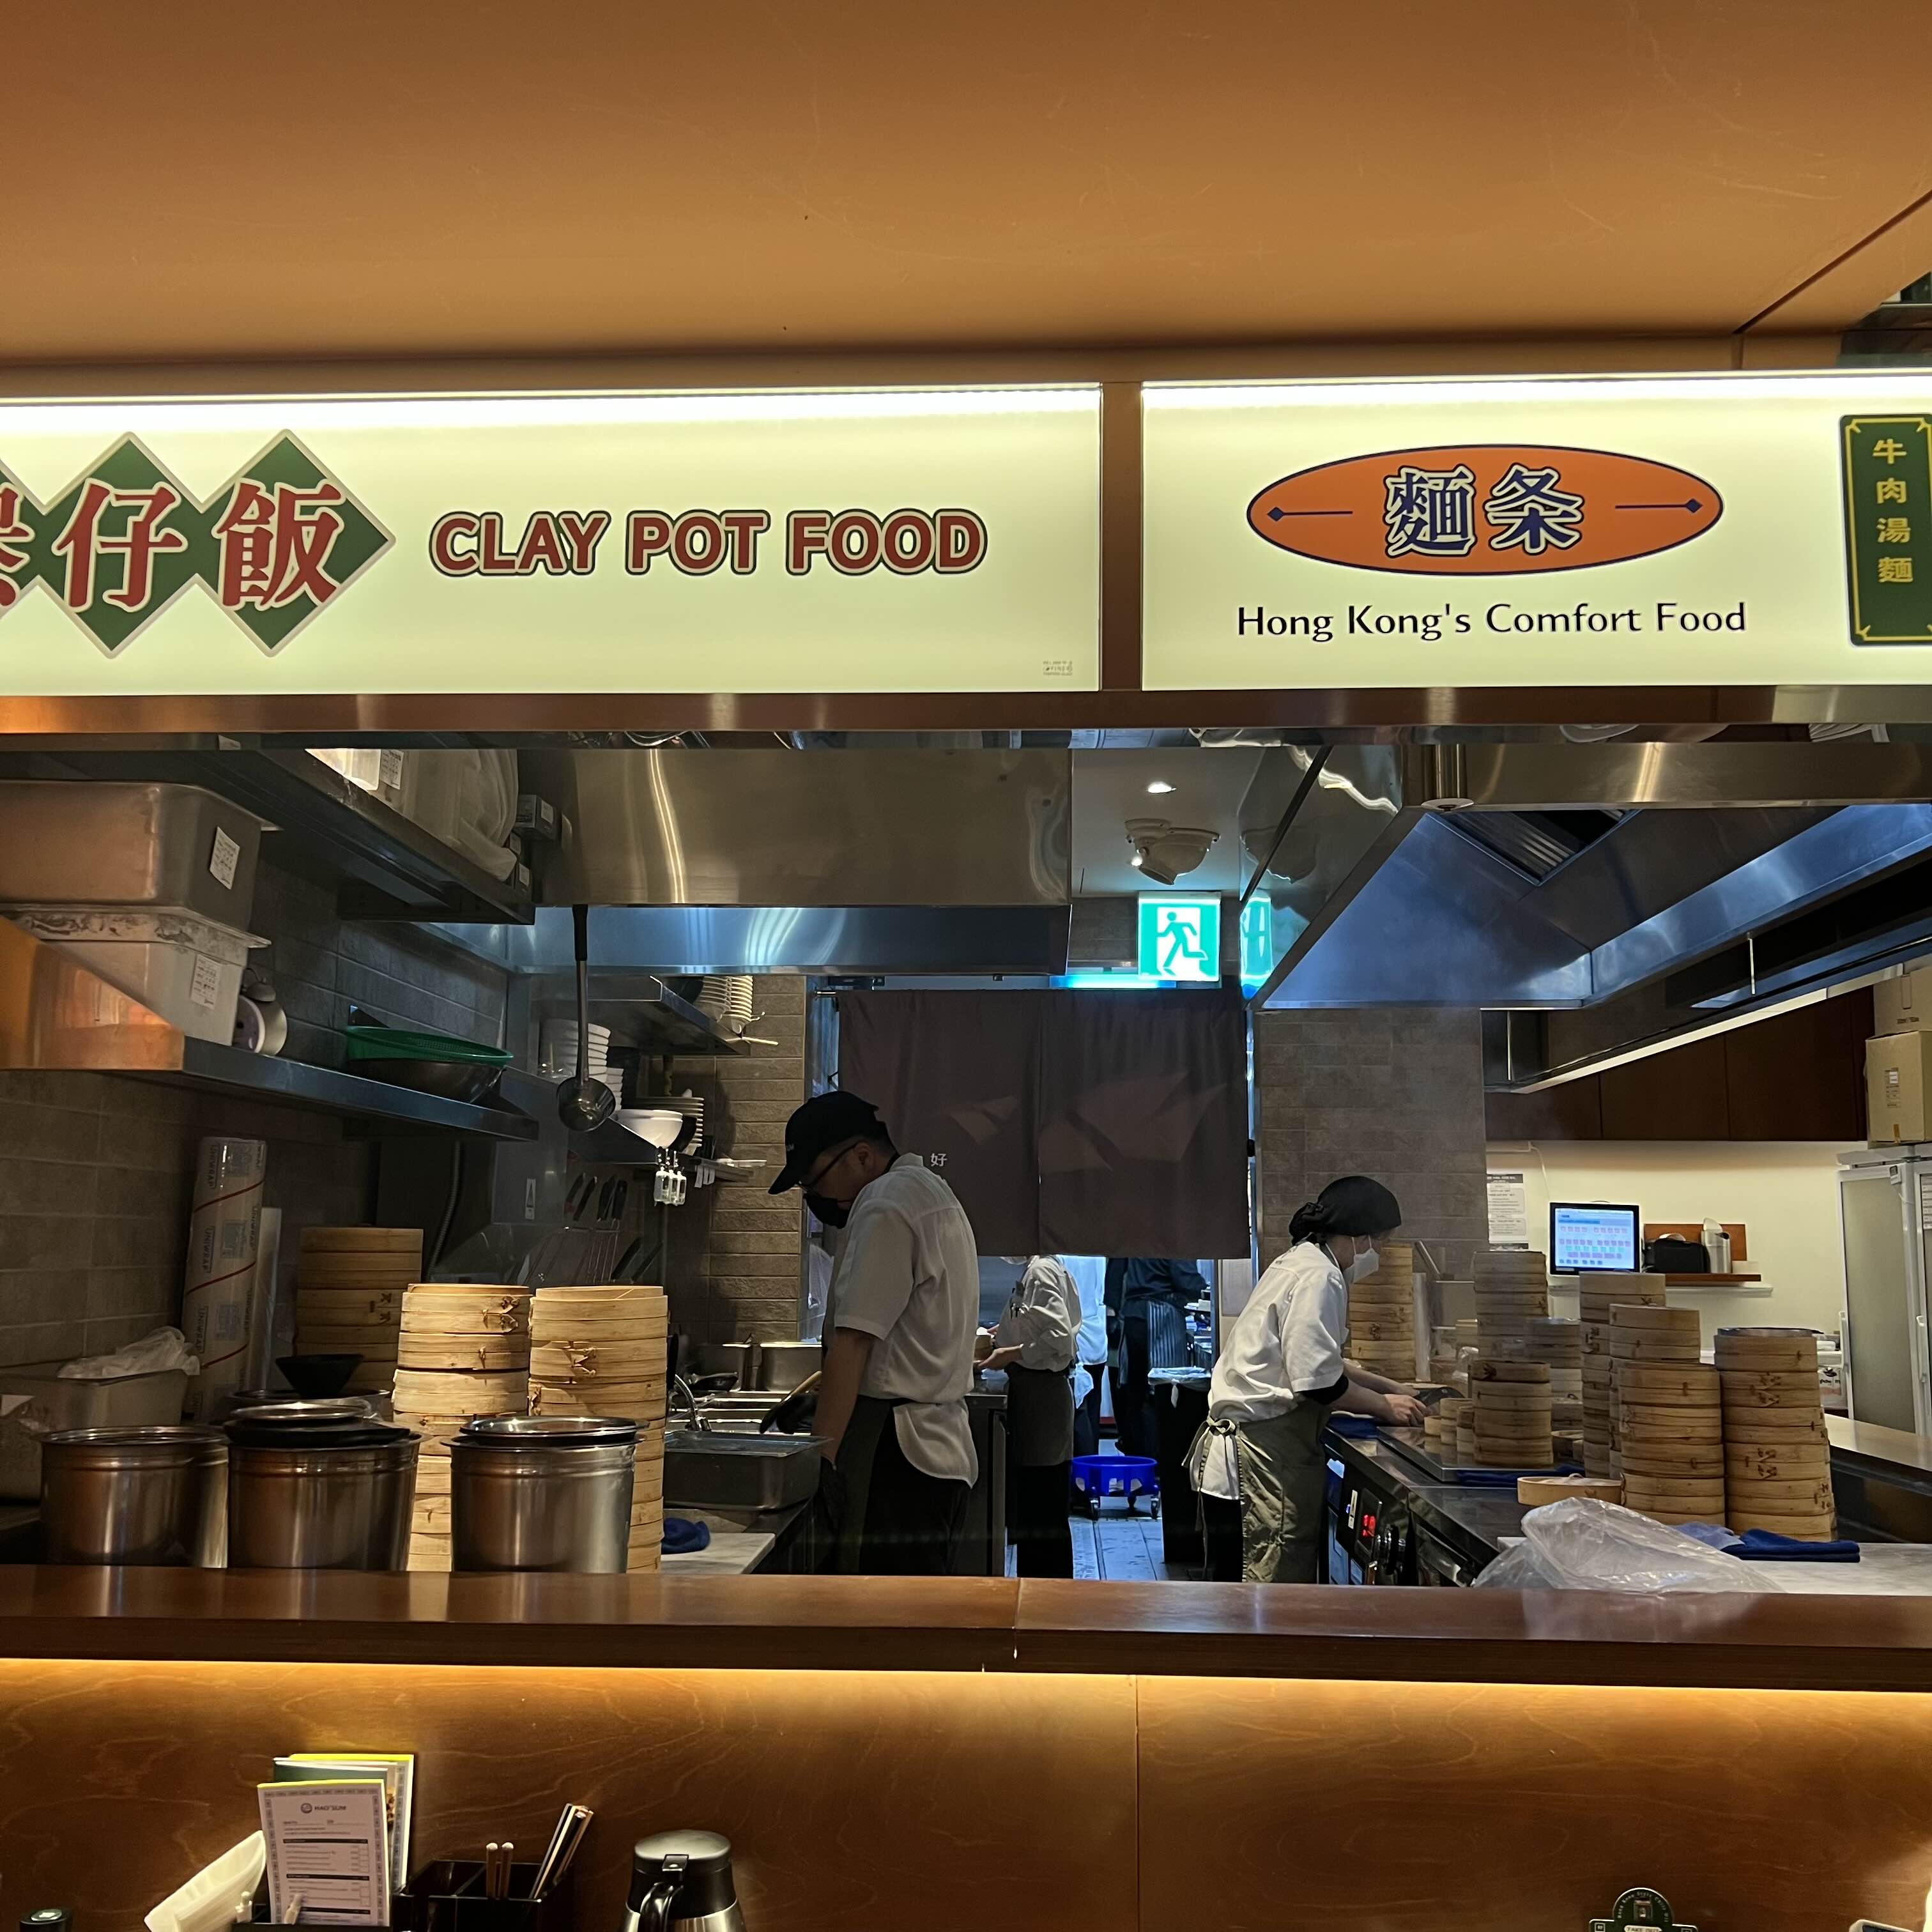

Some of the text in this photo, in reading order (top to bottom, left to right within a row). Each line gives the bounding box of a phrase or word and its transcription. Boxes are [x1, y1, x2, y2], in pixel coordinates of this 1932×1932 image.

[1872, 438, 1914, 583] 牛肉湯麵
[429, 508, 988, 576] CLAY POT FOOD
[1238, 602, 1747, 643] Hong Kong's Comfort Food
[930, 1153, 948, 1167] 好
[203, 1227, 213, 1271] UNIWRAP
[194, 1309, 205, 1352] UNIWRAP
